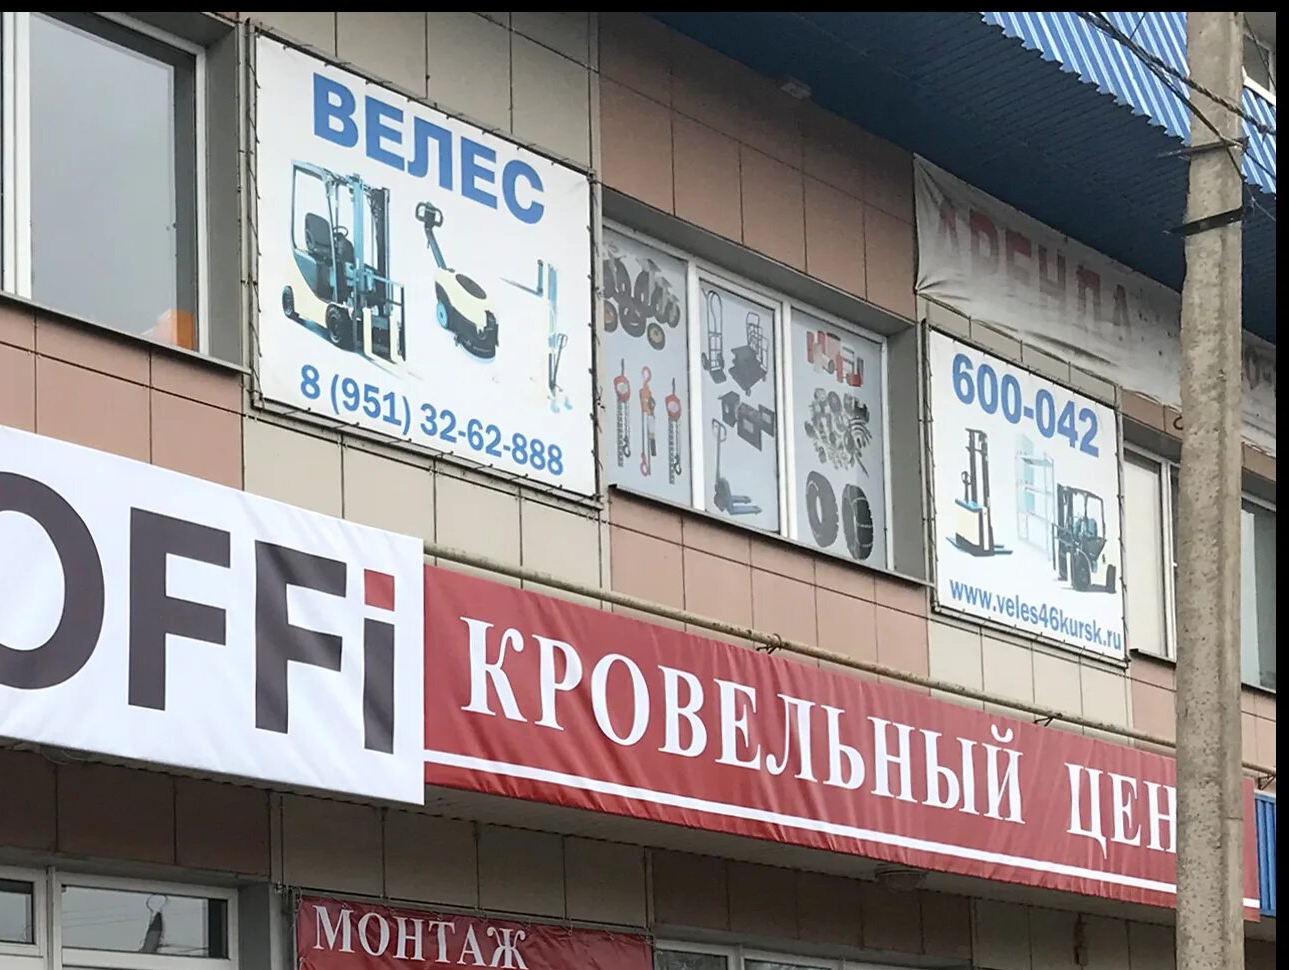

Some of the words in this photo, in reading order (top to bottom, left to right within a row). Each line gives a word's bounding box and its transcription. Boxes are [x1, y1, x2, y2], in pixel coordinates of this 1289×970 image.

[312, 72, 545, 225] ВЕЛЕС
[300, 364, 321, 400] 8
[330, 374, 411, 435] (951)
[420, 403, 564, 476] 32-62-888
[952, 353, 1099, 457] 600-042
[950, 578, 1122, 651] www.veles46kursk.ru
[459, 616, 1025, 824] КРОВЕЛЬНЫЙ
[1064, 762, 1177, 860] ЦЕН
[312, 905, 529, 970] МОНТАЖ
